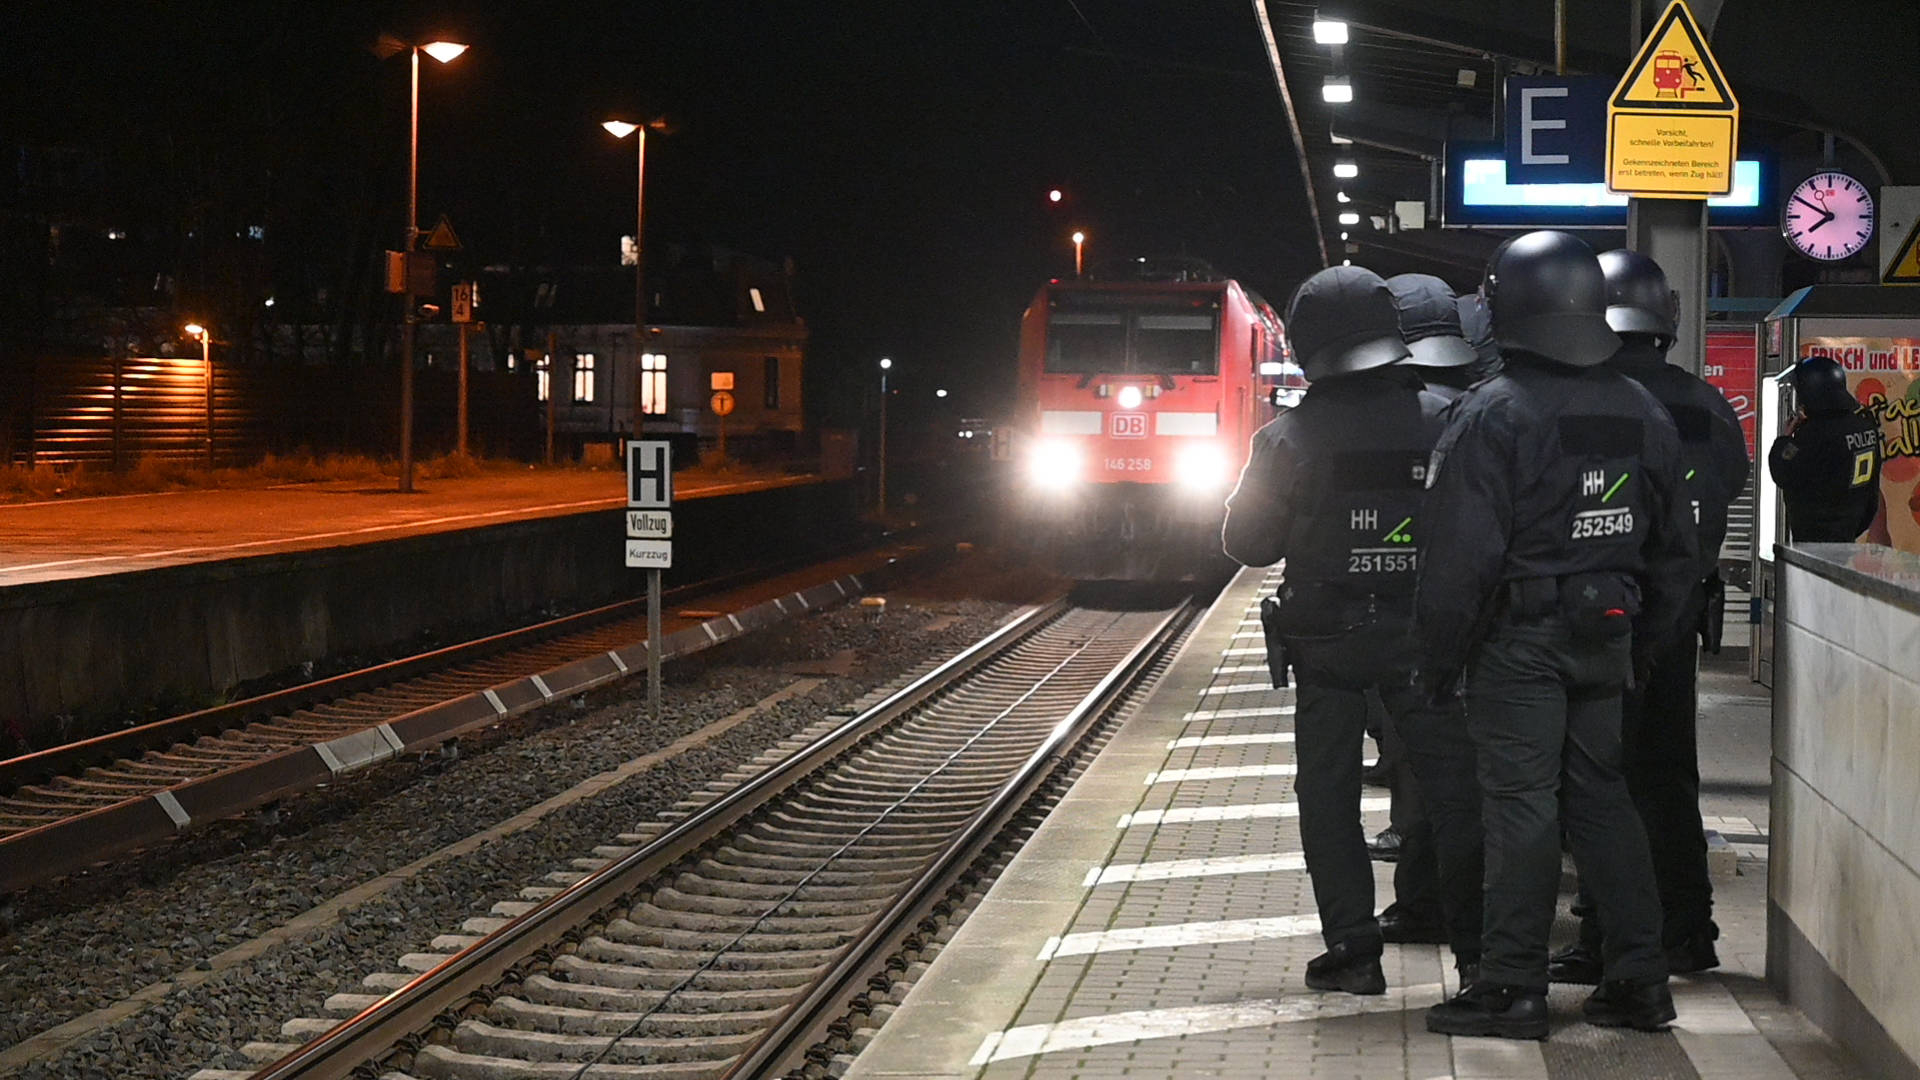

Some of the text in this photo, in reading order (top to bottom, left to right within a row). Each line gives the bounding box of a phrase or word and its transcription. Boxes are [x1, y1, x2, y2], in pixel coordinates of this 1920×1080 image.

[1521, 87, 1570, 165] E
[1629, 139, 1661, 147] schnelle
[1691, 160, 1720, 168] Bereich
[1690, 170, 1705, 180] Zug
[454, 288, 469, 301] 16
[456, 303, 464, 315] 4
[1869, 347, 1898, 370] und
[1704, 365, 1724, 377] en
[1115, 417, 1142, 434] DB
[1845, 431, 1878, 451] POLIZE
[1104, 457, 1153, 471] 146 258
[632, 447, 665, 501] H
[1583, 469, 1604, 497] HH
[630, 513, 667, 535] Vollzug
[1351, 509, 1378, 531] HH
[1571, 512, 1634, 540] 252549
[629, 548, 668, 562] Kurzzug
[1348, 554, 1417, 573] 251551
